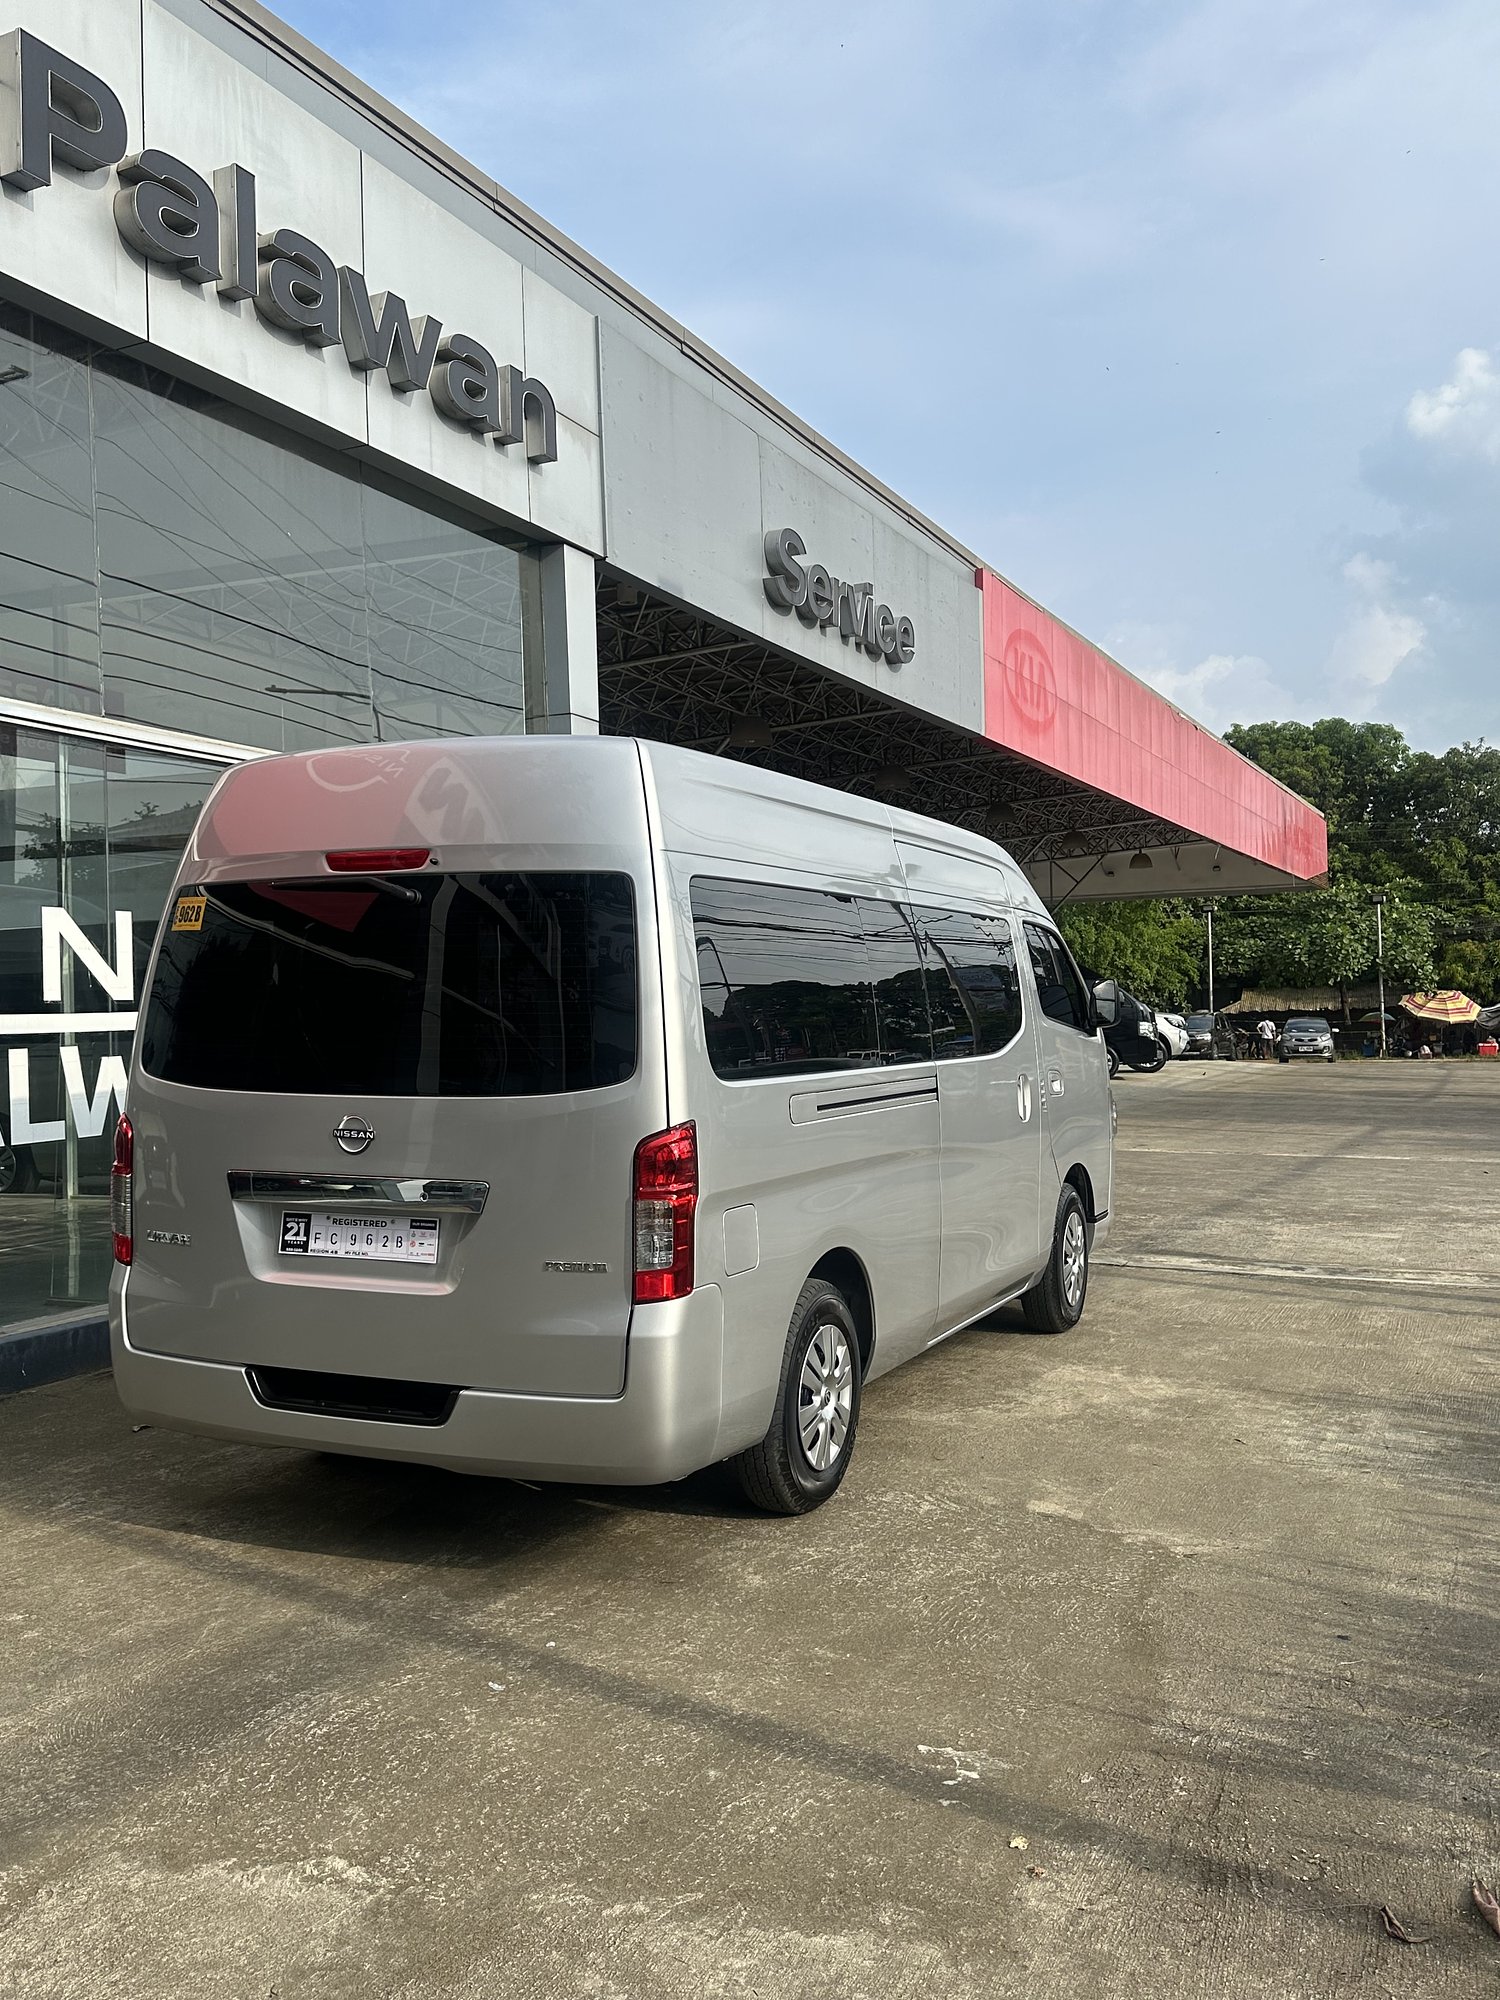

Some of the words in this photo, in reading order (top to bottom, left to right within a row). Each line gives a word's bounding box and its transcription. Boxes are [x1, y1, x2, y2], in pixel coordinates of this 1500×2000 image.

[0, 27, 558, 465] Palawan
[763, 527, 915, 665] Service
[1013, 647, 1050, 716] KIA
[178, 905, 202, 923] 962B
[0, 1045, 128, 1147] LW
[333, 1130, 374, 1139] NISSAN
[284, 1222, 307, 1241] 21
[332, 1217, 388, 1228] REGISTERED
[543, 1260, 609, 1273] PREMIUM
